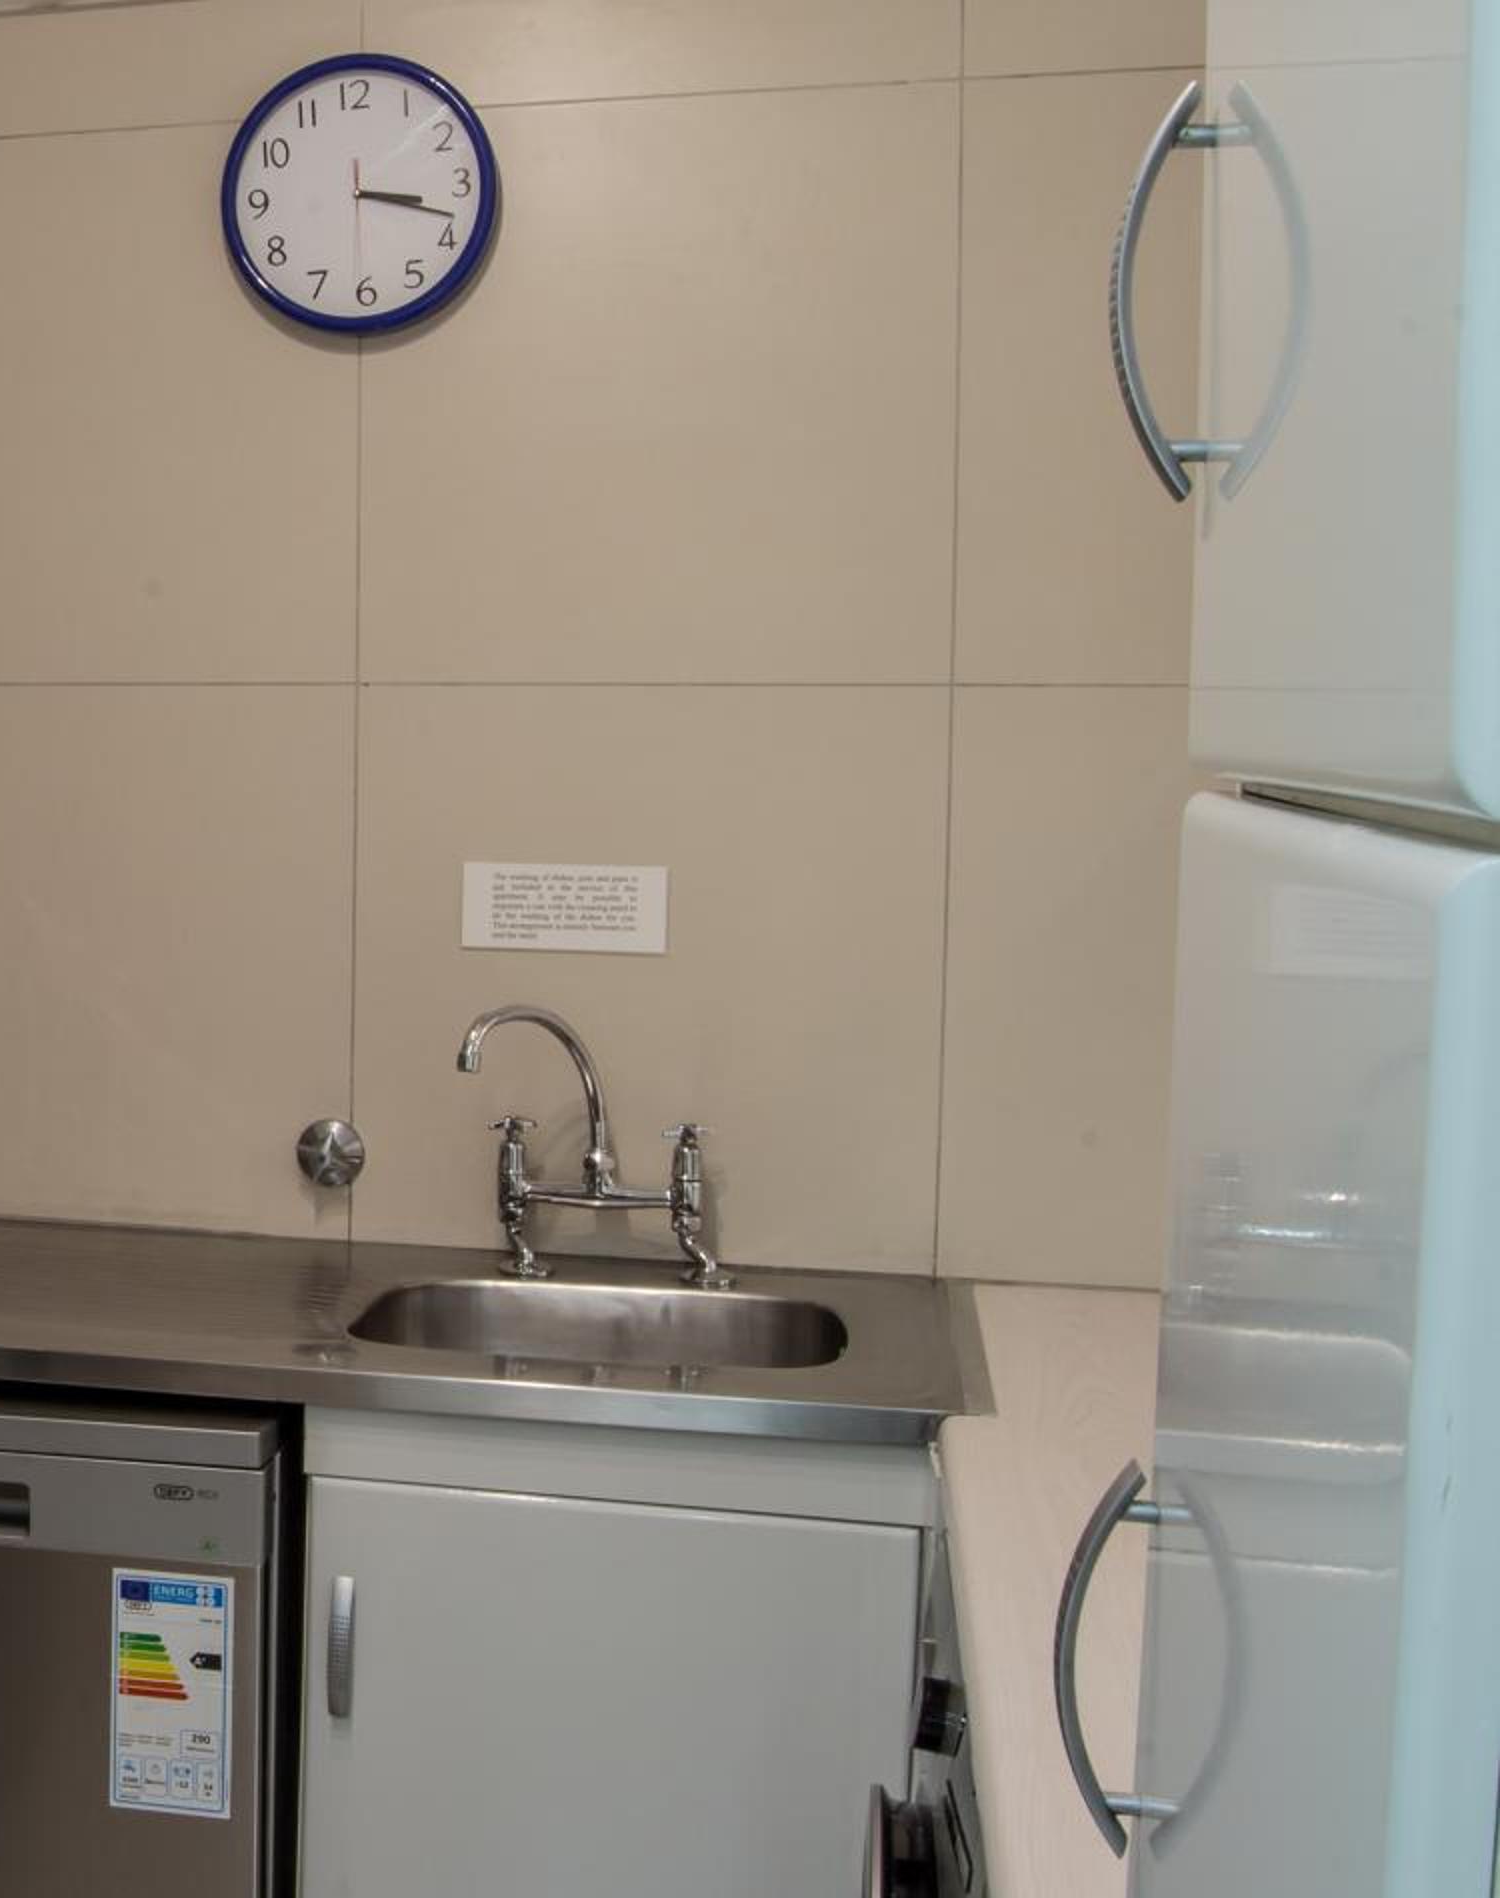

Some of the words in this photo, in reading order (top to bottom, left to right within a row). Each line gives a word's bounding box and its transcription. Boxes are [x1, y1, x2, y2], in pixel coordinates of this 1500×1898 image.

[339, 79, 371, 111] 12
[402, 88, 410, 118] 1
[298, 99, 317, 129] 11
[433, 121, 454, 153] 2
[262, 137, 290, 168] 10
[452, 168, 471, 198] 3
[247, 189, 270, 221] 9
[266, 235, 288, 267] 8
[437, 222, 458, 251] 4
[306, 269, 330, 300] 7
[404, 259, 425, 289] 5
[356, 277, 378, 306] 6
